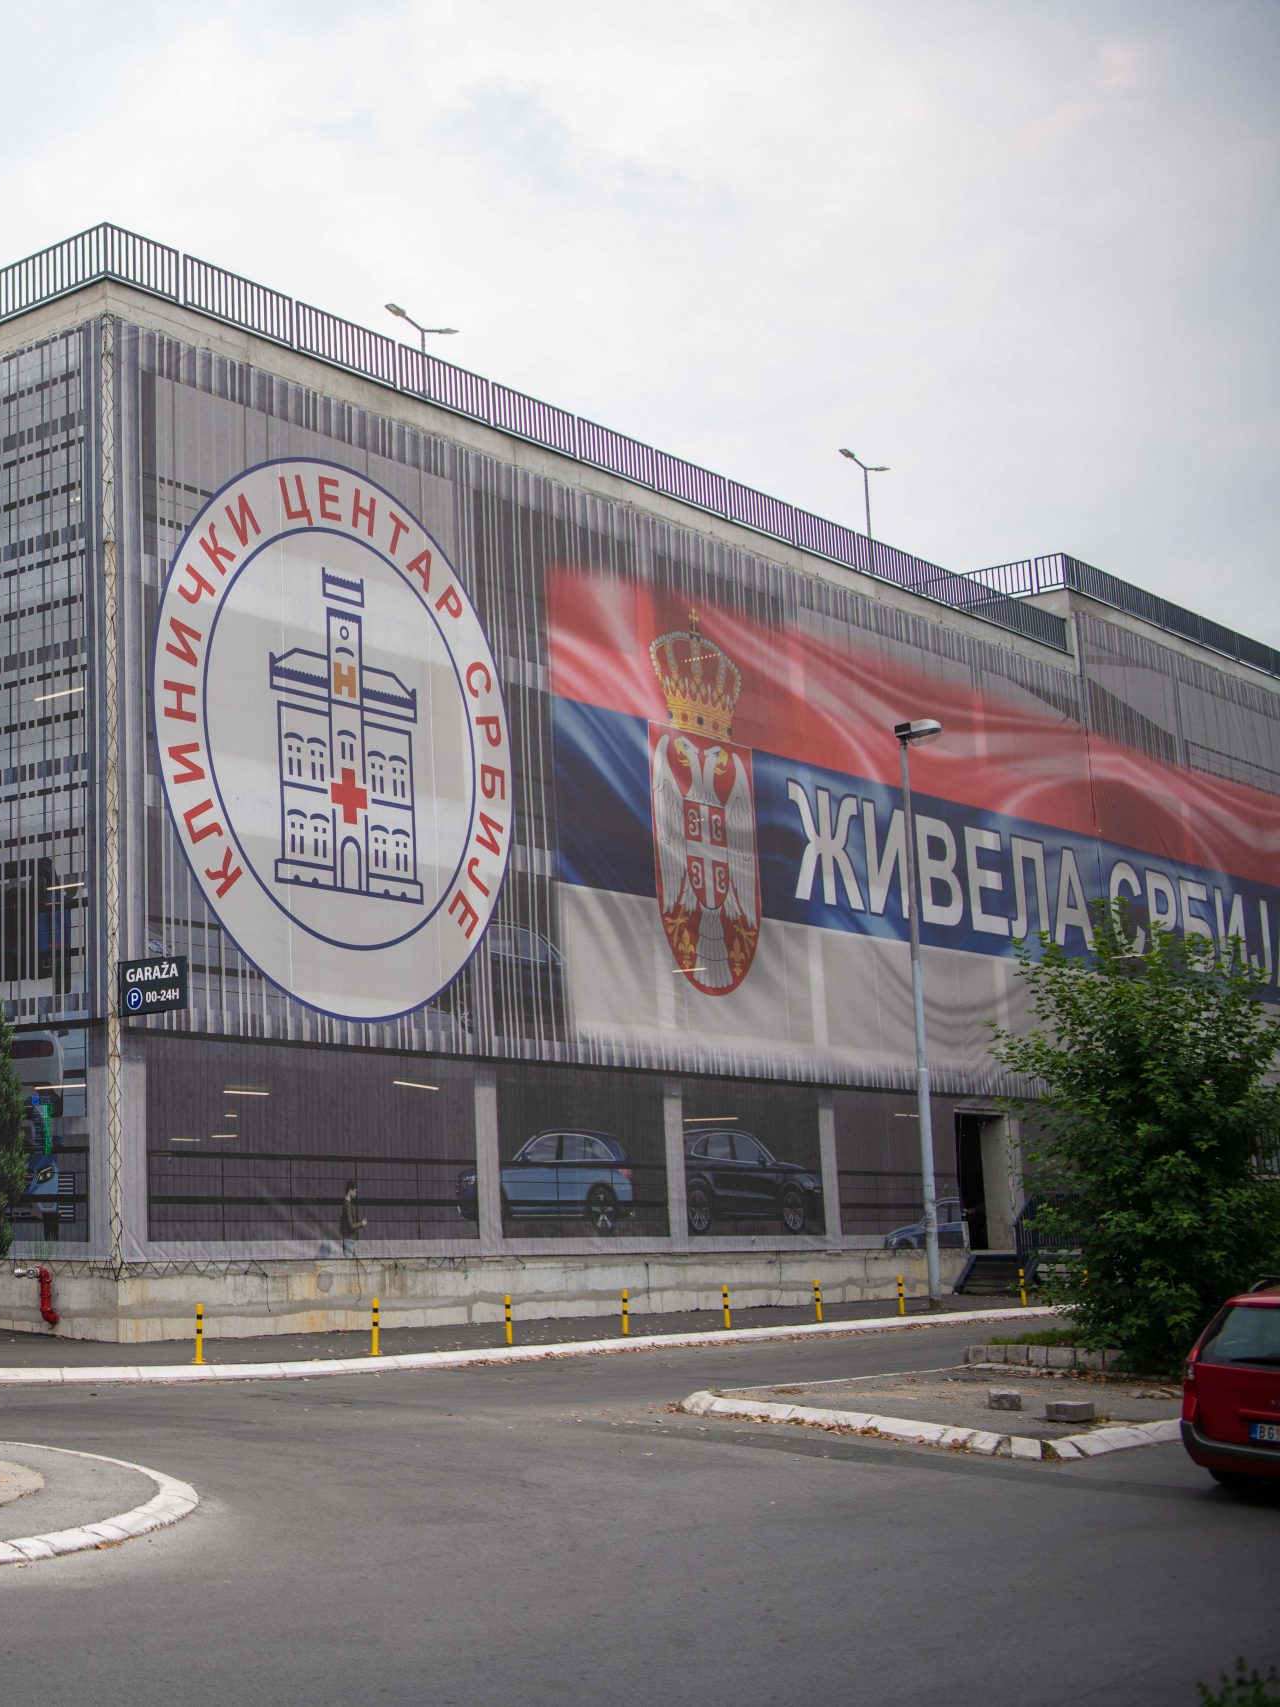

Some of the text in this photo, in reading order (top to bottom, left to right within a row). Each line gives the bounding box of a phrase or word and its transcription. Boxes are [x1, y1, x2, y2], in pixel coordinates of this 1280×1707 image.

[163, 474, 506, 939] КЛИНИЧКИ ЦЕНТАР СРБИЈЕ
[786, 779, 1280, 986] ЖИВЕЛА СРБИЈ
[126, 961, 179, 983] GARAŽA
[145, 988, 179, 1003] 00-24H
